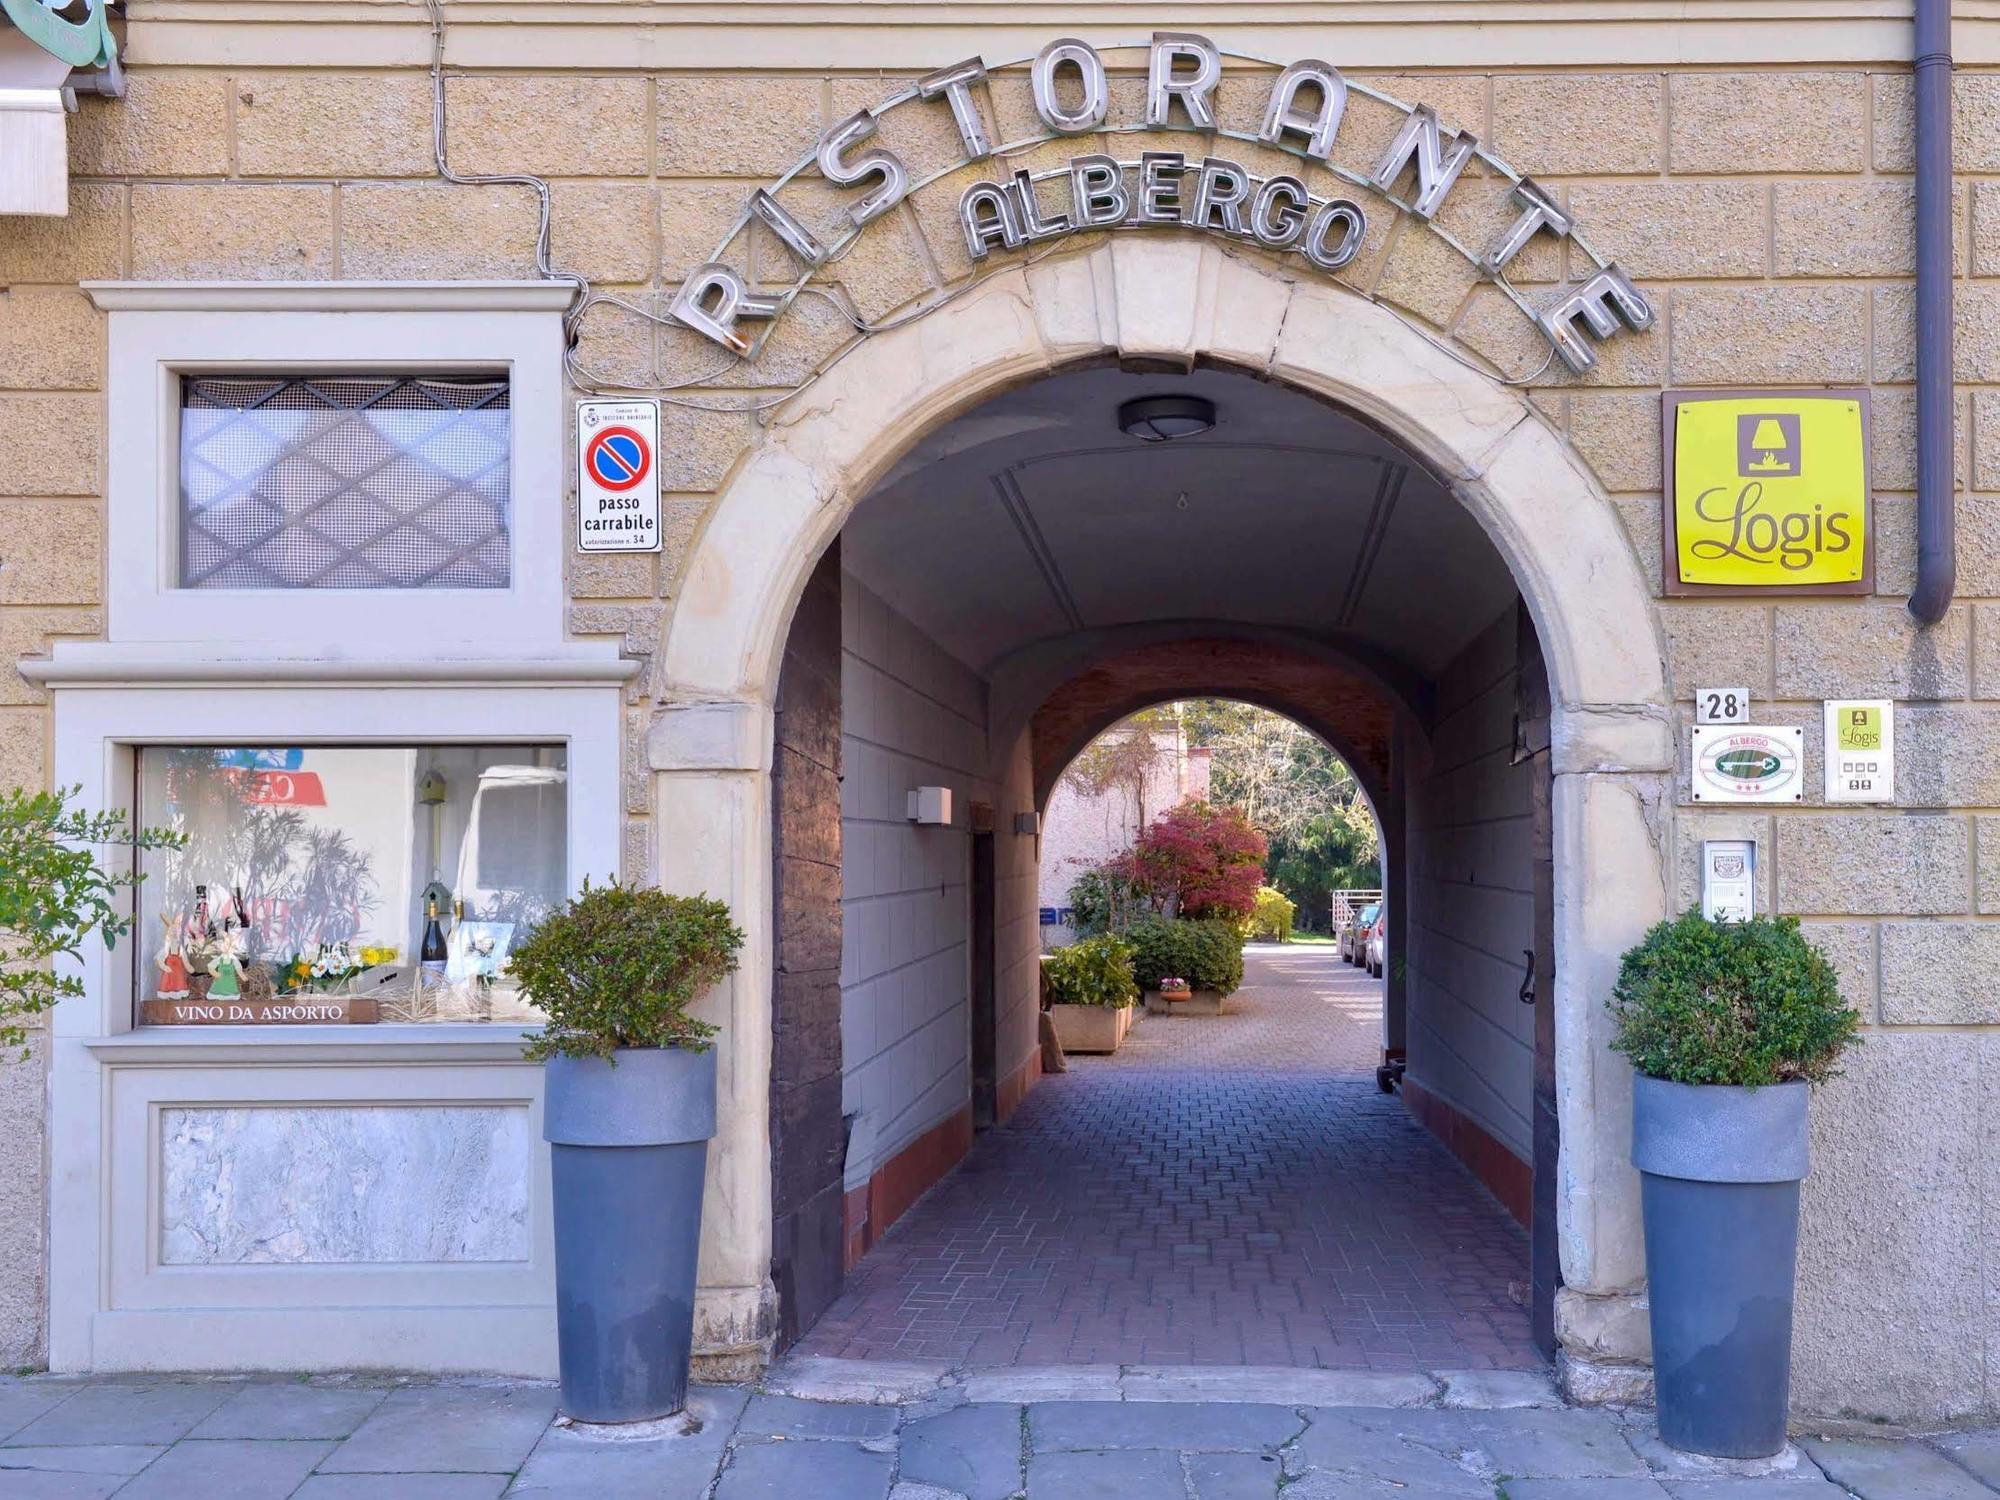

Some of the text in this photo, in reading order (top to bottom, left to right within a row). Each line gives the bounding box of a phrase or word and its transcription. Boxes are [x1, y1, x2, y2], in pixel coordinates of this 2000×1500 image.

[668, 32, 1655, 374] RISTORANTE
[958, 151, 1368, 273] ALBERGO
[599, 498, 640, 513] passo
[584, 514, 654, 531] carrabile
[1690, 481, 1851, 571] Logis
[633, 534, 645, 544] 34
[1707, 693, 1739, 719] 28
[1729, 736, 1769, 747] ALBERGO
[1841, 727, 1879, 747] Logis
[175, 1005, 342, 1020] VINO DA ASPORTO
